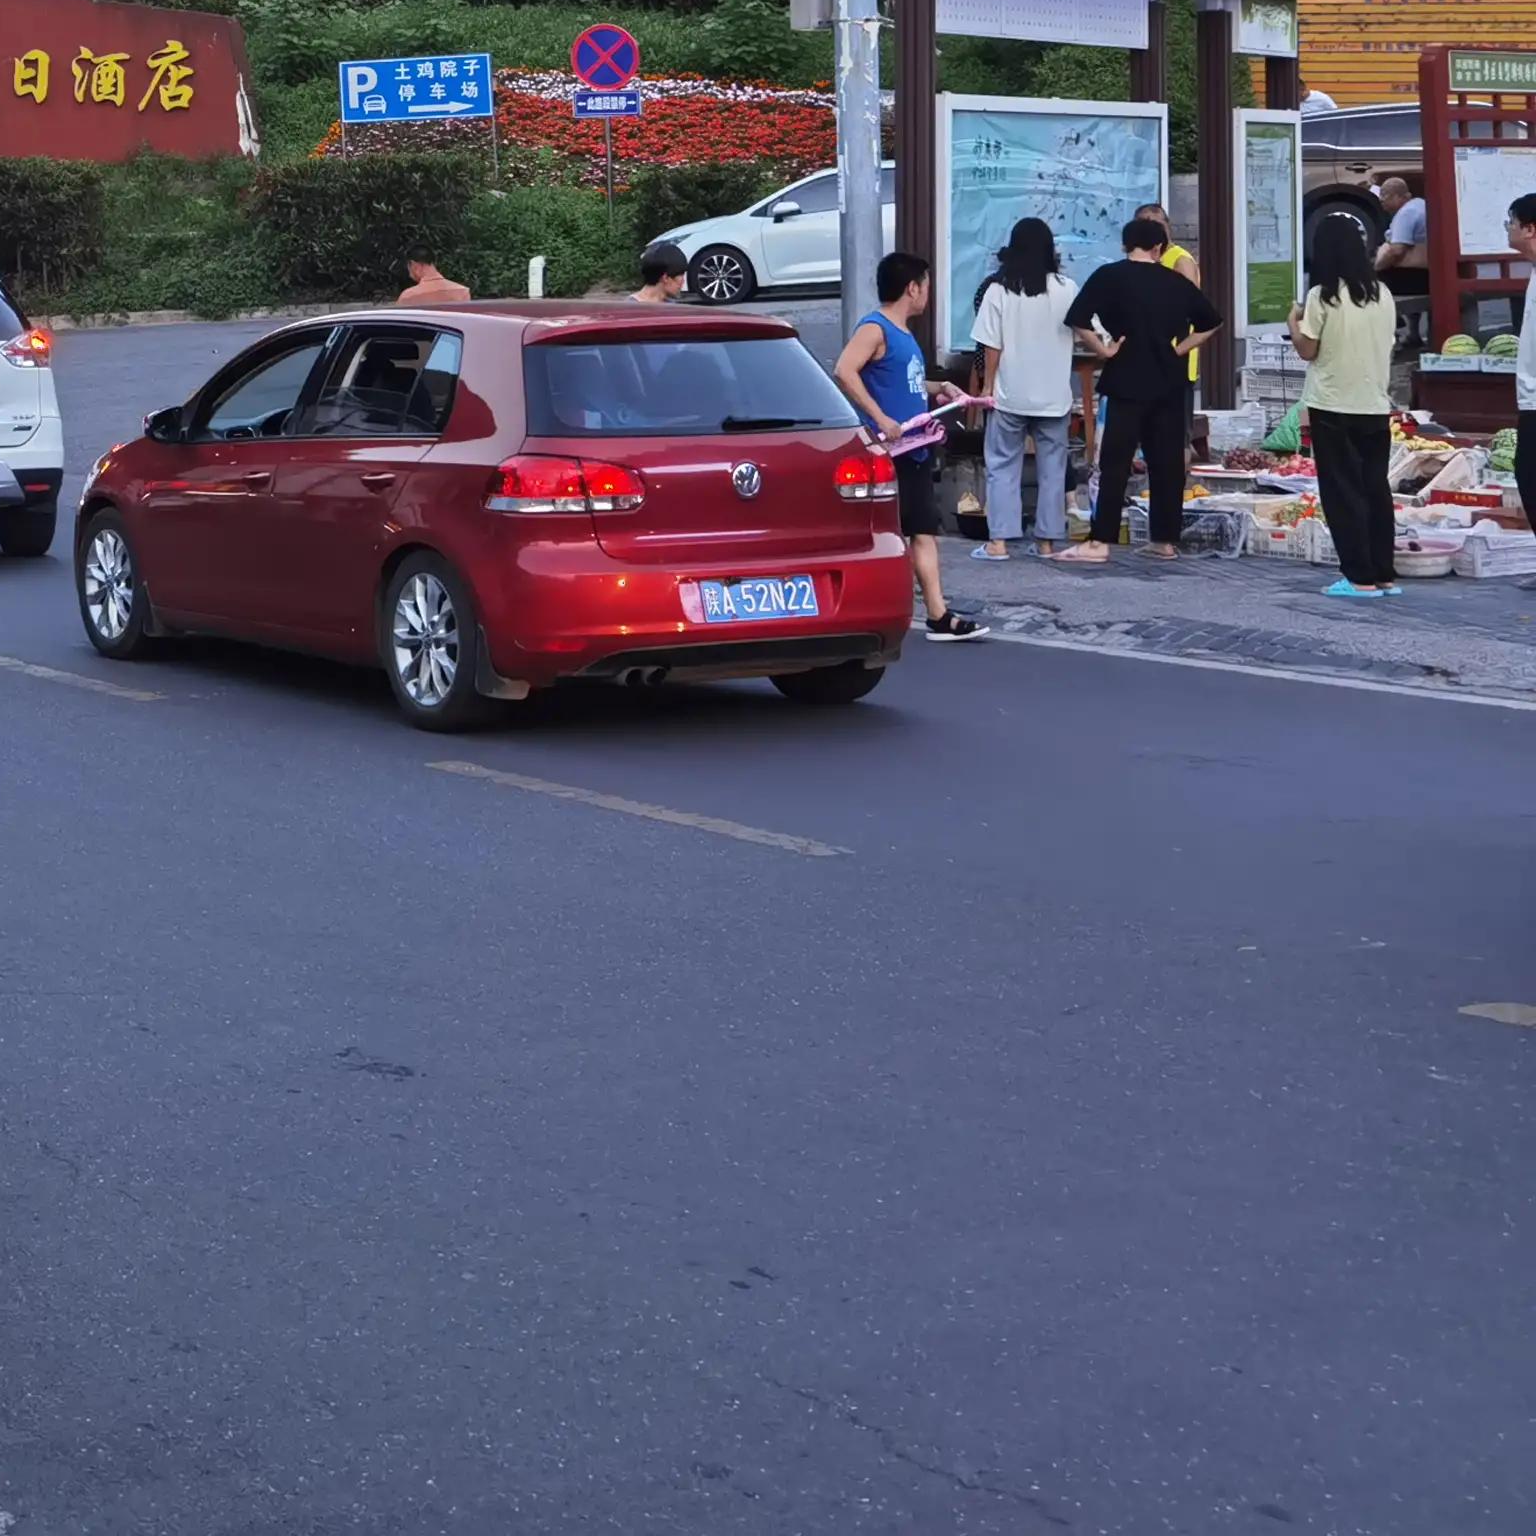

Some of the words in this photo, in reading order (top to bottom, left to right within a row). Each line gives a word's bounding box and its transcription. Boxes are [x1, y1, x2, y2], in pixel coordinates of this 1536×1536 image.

[394, 59, 481, 82] 土鸡院子
[347, 66, 378, 110] P
[398, 82, 479, 103] 停车场
